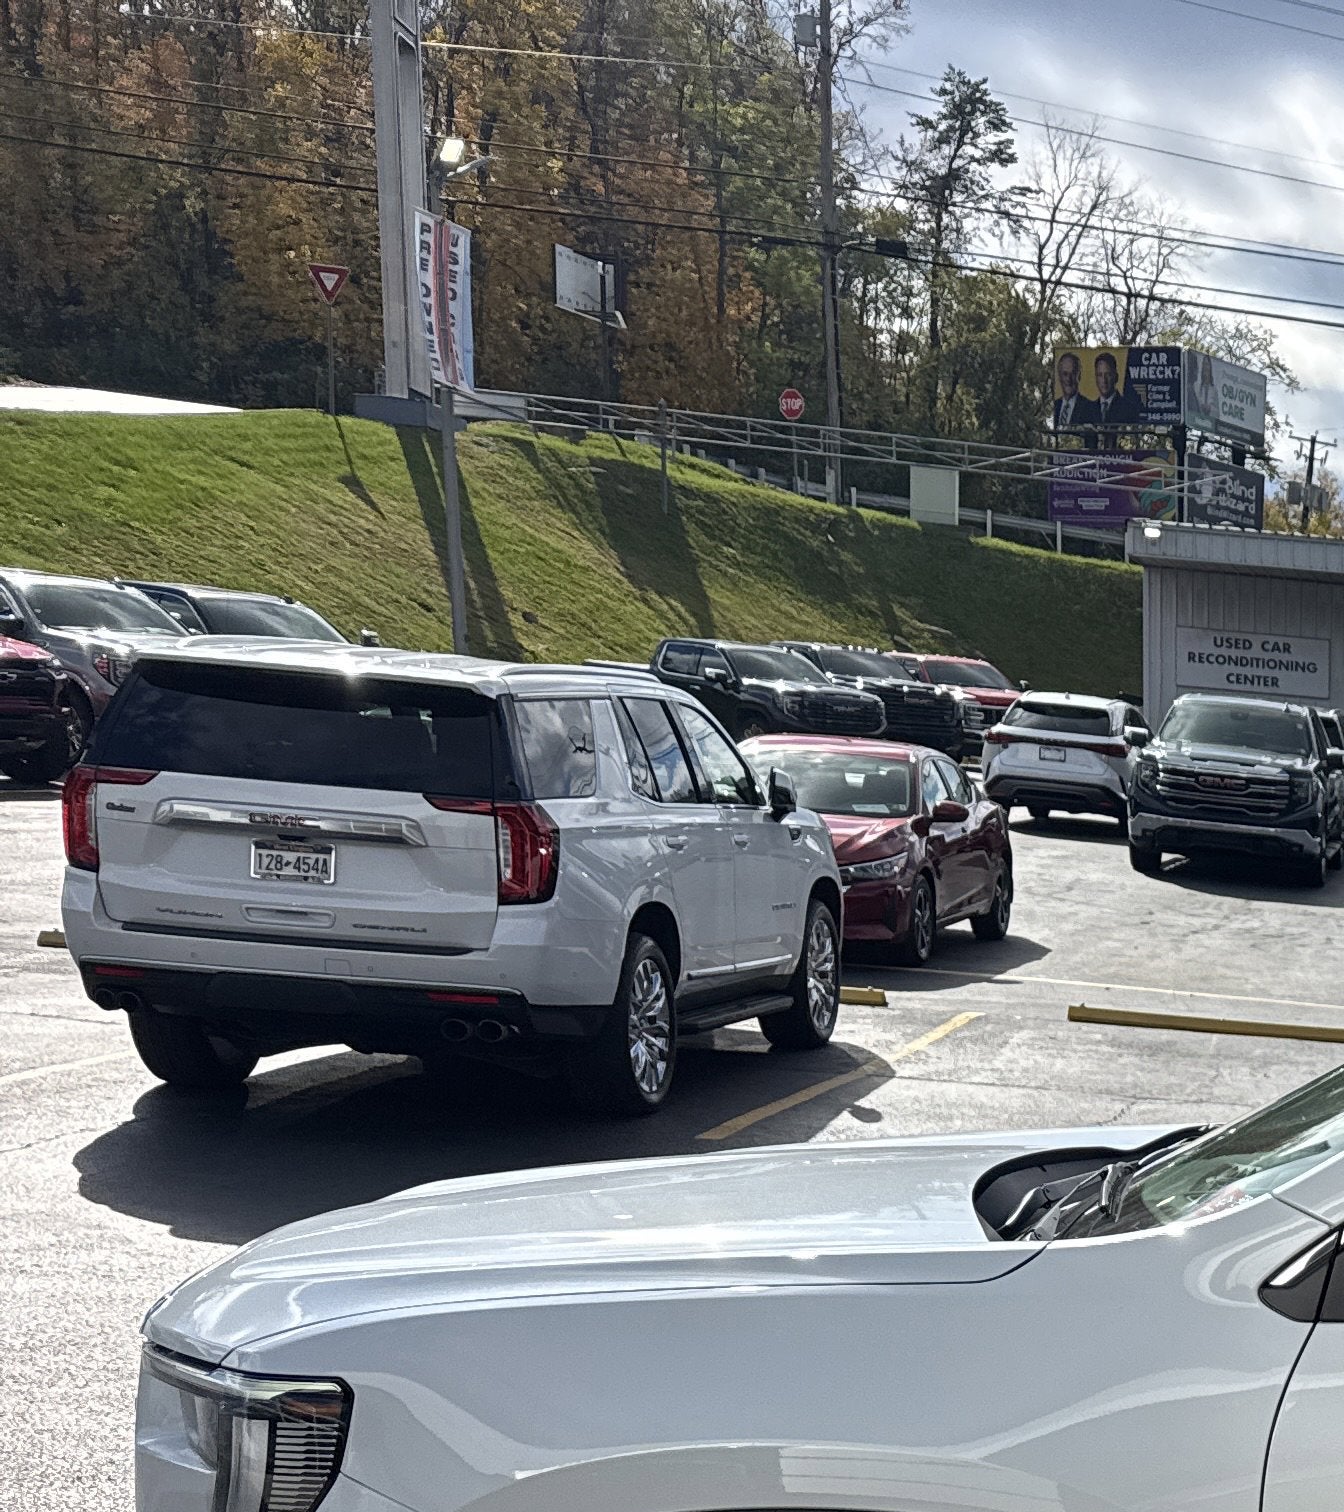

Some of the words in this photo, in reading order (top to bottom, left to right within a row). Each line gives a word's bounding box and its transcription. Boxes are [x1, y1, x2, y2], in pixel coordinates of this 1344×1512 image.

[1141, 352, 1168, 365] CAR
[1129, 366, 1181, 379] WRECK?
[781, 398, 802, 410] STOP
[1221, 383, 1257, 408] OB/GYN
[1221, 401, 1245, 421] CARE
[1213, 636, 1253, 650] USED
[1261, 640, 1292, 654] CAR
[1187, 651, 1318, 674] RECONDITIONING
[1226, 672, 1280, 688] CENTER
